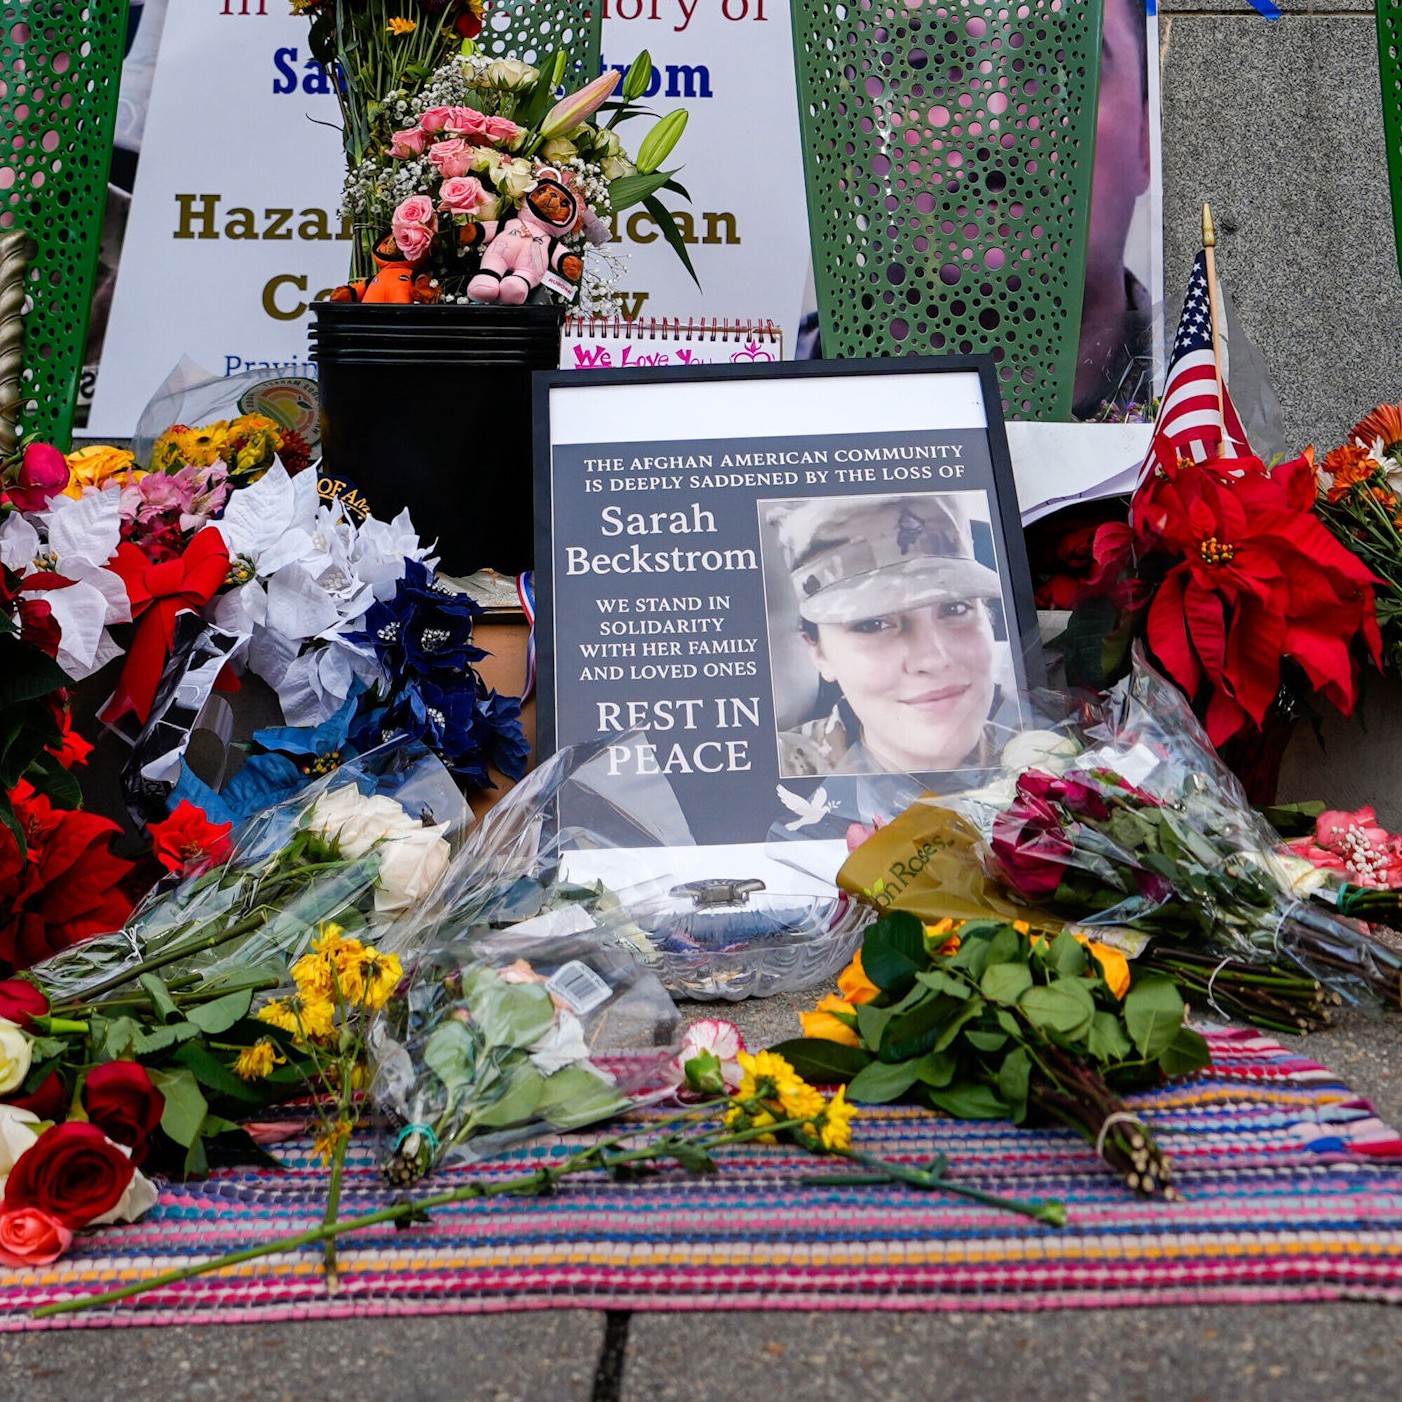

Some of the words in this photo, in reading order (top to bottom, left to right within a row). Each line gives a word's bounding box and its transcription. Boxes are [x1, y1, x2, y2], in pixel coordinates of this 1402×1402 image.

[173, 193, 354, 241] Hazar
[224, 355, 319, 379] Prayin
[573, 344, 613, 368] We
[622, 345, 670, 368] Love
[584, 458, 625, 472] THE
[630, 454, 714, 471] AFGHAN
[720, 450, 829, 468] AMERICAN
[834, 444, 964, 463] COMMUNITY
[584, 478, 604, 493] IS
[610, 475, 684, 492] DEEPLY
[689, 471, 799, 489] SADDENED
[805, 470, 829, 485] BY
[834, 468, 877, 484] THE
[882, 465, 933, 482] LOSS
[938, 464, 966, 479] OF
[601, 502, 719, 537] Sarah
[565, 543, 760, 576] Beckstrom
[596, 599, 631, 613] WE
[635, 596, 703, 612] STAND
[708, 596, 731, 611] IN
[600, 617, 726, 636] SOLIDARITY
[579, 642, 636, 659] WITH
[642, 641, 683, 657] HER
[688, 638, 759, 656] FAMILY
[579, 666, 625, 682] AND
[630, 663, 698, 680] LOVED
[703, 661, 758, 678] ONES
[596, 699, 704, 732] REST
[714, 697, 761, 729] IN
[606, 740, 753, 777] PEACE
